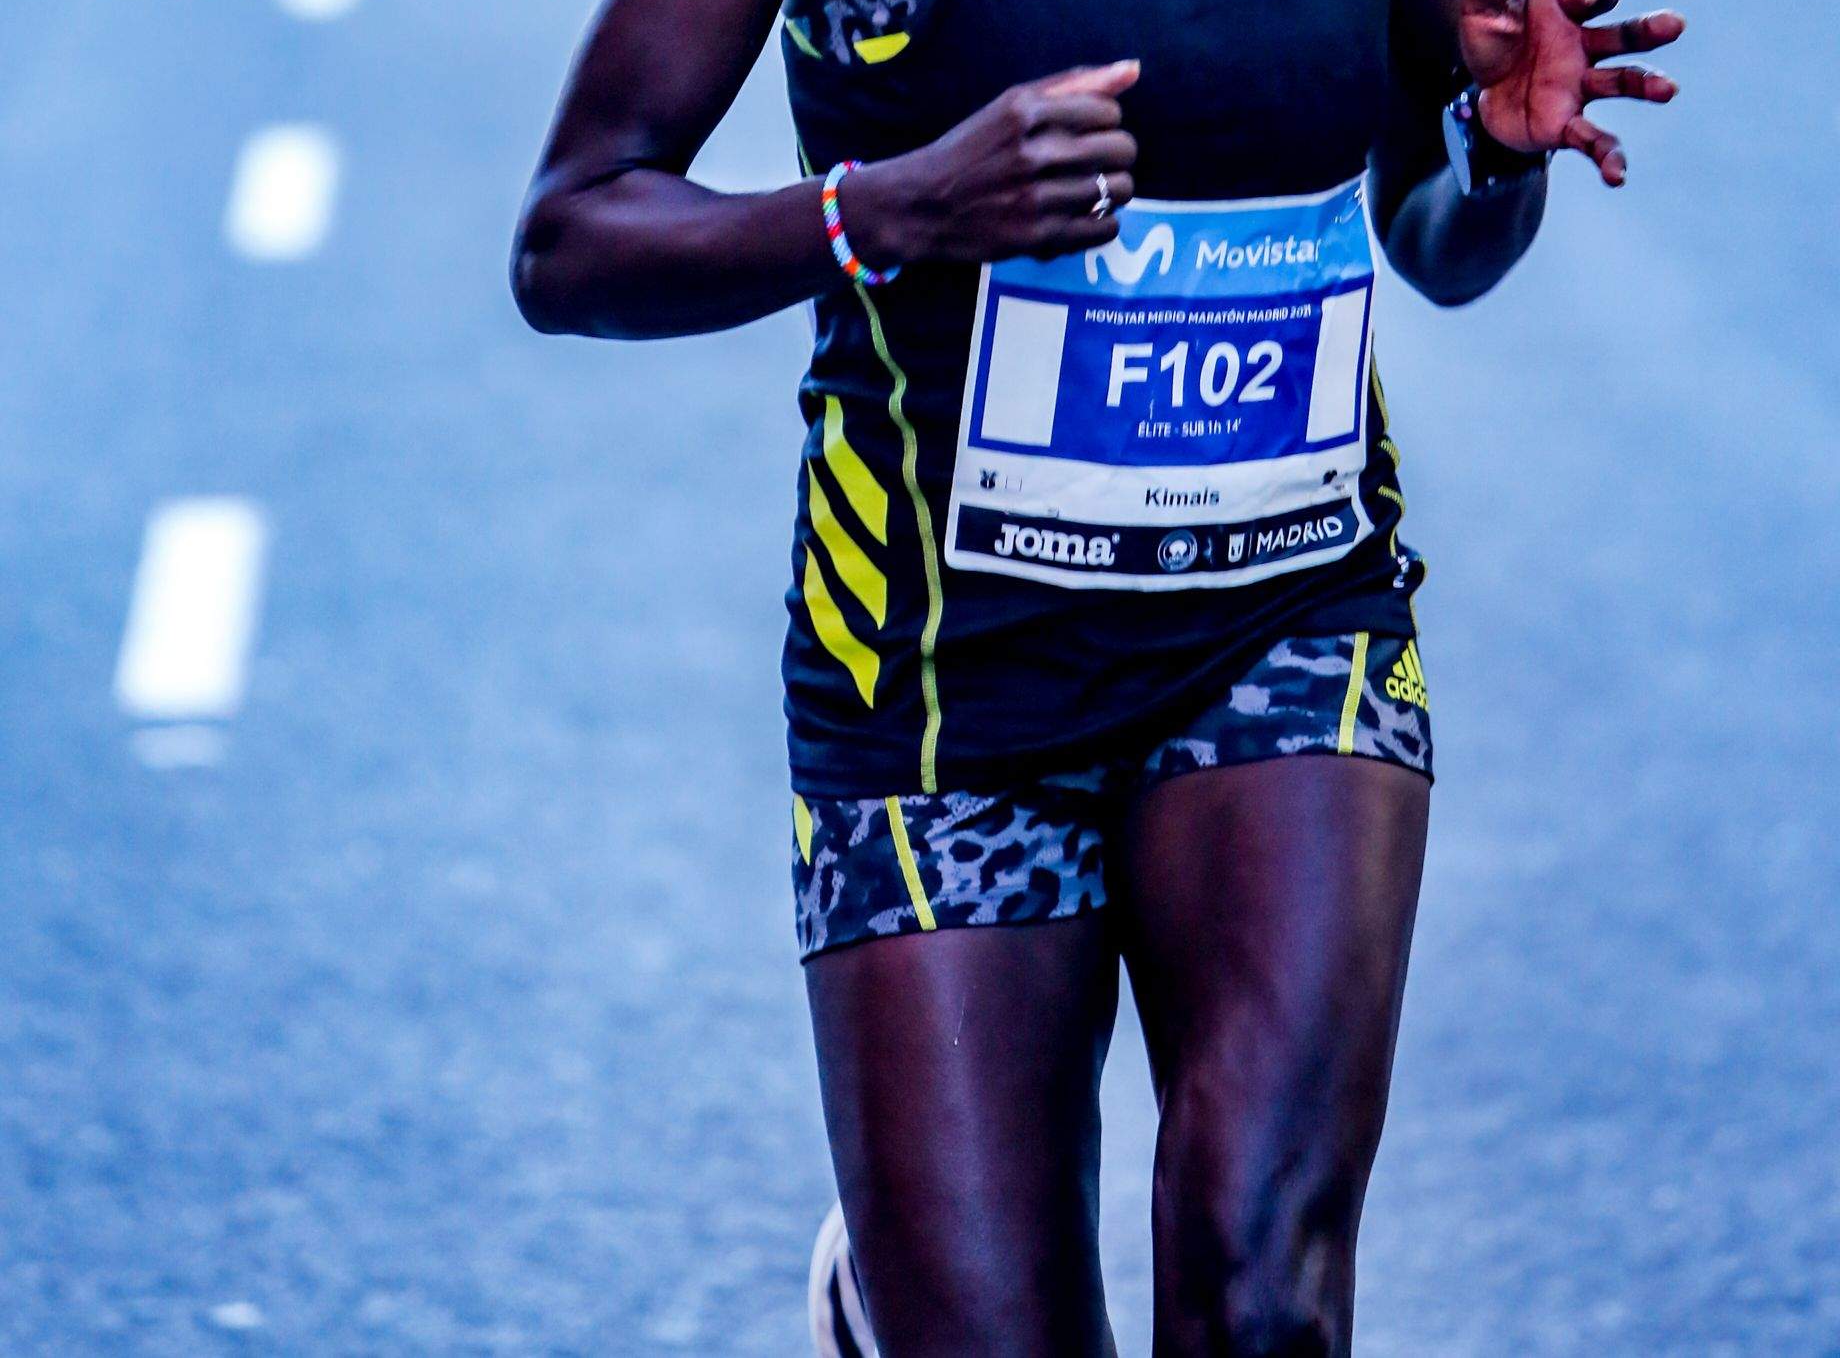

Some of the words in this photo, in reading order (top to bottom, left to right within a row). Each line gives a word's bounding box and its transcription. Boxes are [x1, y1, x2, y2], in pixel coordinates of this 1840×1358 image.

[1085, 308, 1145, 326] MOVISTAR
[1147, 310, 1186, 324] MEDIO
[1188, 308, 1245, 324] MARATÓN
[1246, 306, 1289, 323] MADRID
[1106, 340, 1284, 408] F102
[1181, 419, 1205, 438] SUB
[1145, 486, 1220, 507] Kimais
[1256, 516, 1343, 555] MADRID
